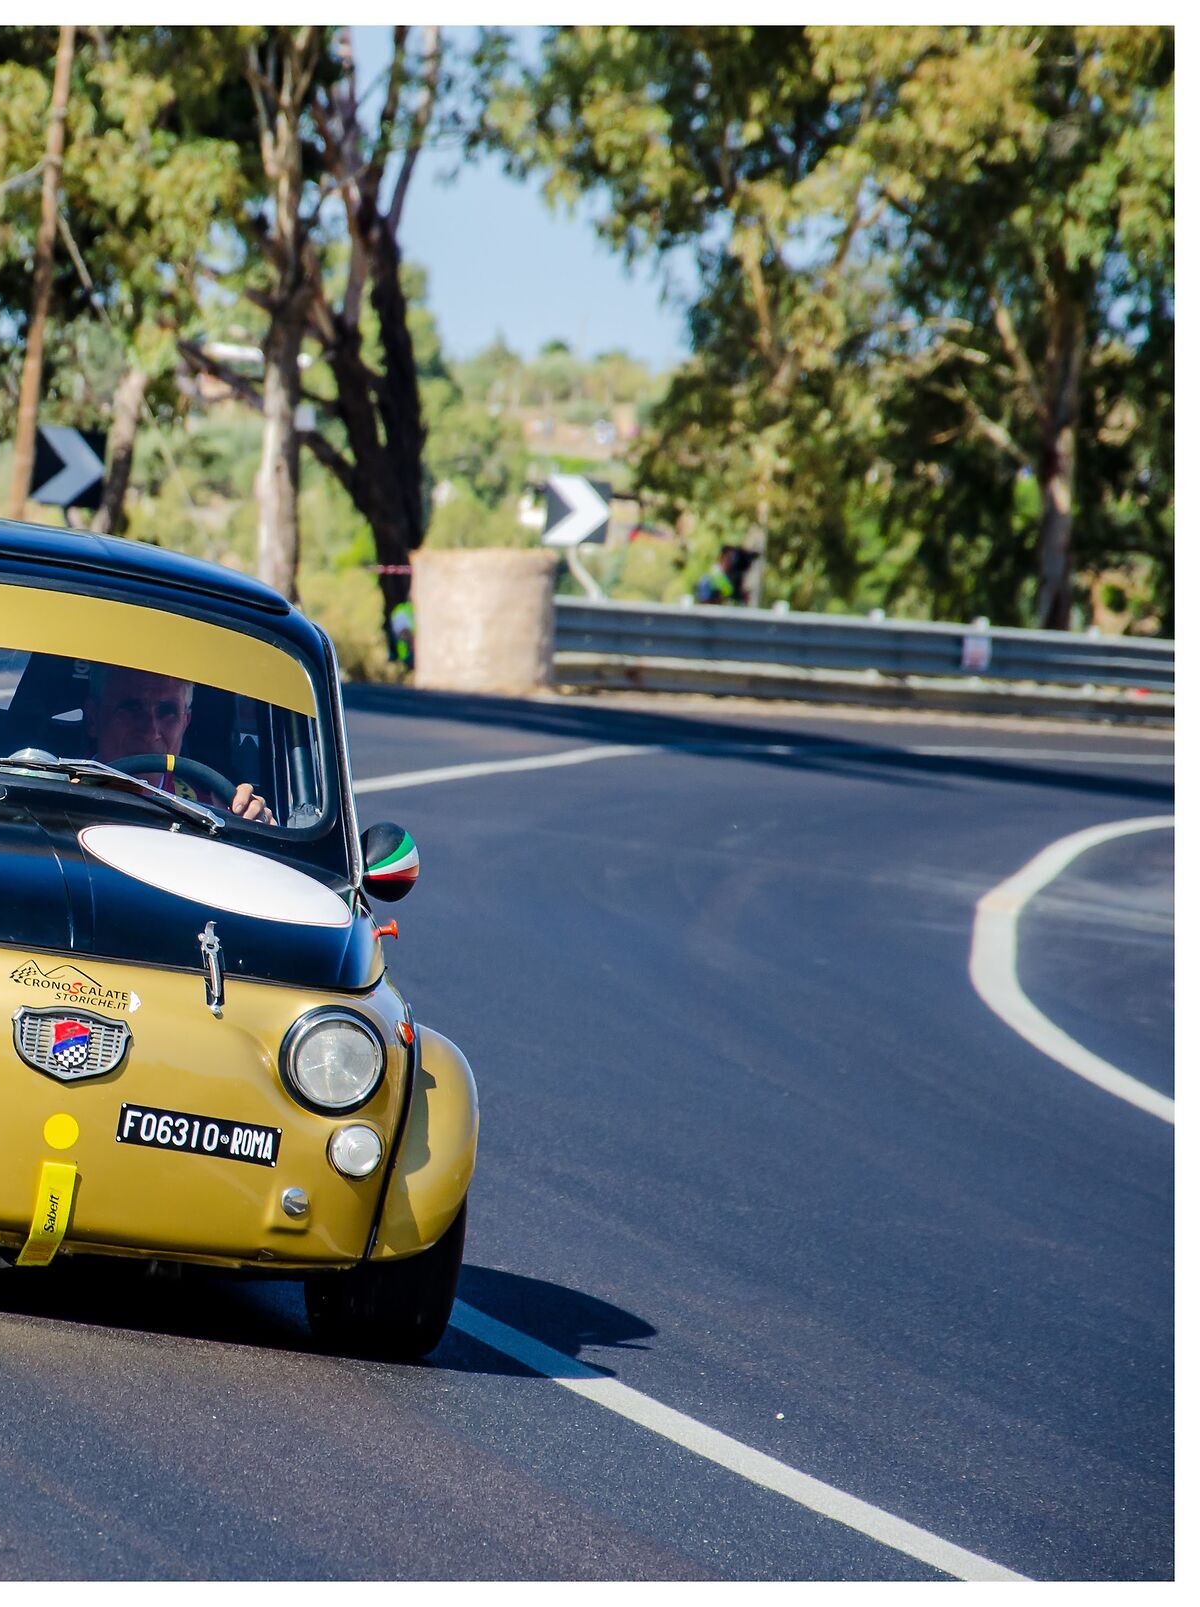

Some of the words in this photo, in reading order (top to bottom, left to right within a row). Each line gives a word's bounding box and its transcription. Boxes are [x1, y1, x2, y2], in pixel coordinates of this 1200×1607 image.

[23, 976, 129, 1001] CRONOSCALATE
[54, 992, 129, 1011] STORICHE.IT
[229, 1126, 274, 1161] ROMA
[43, 1194, 60, 1233] Sabelt
